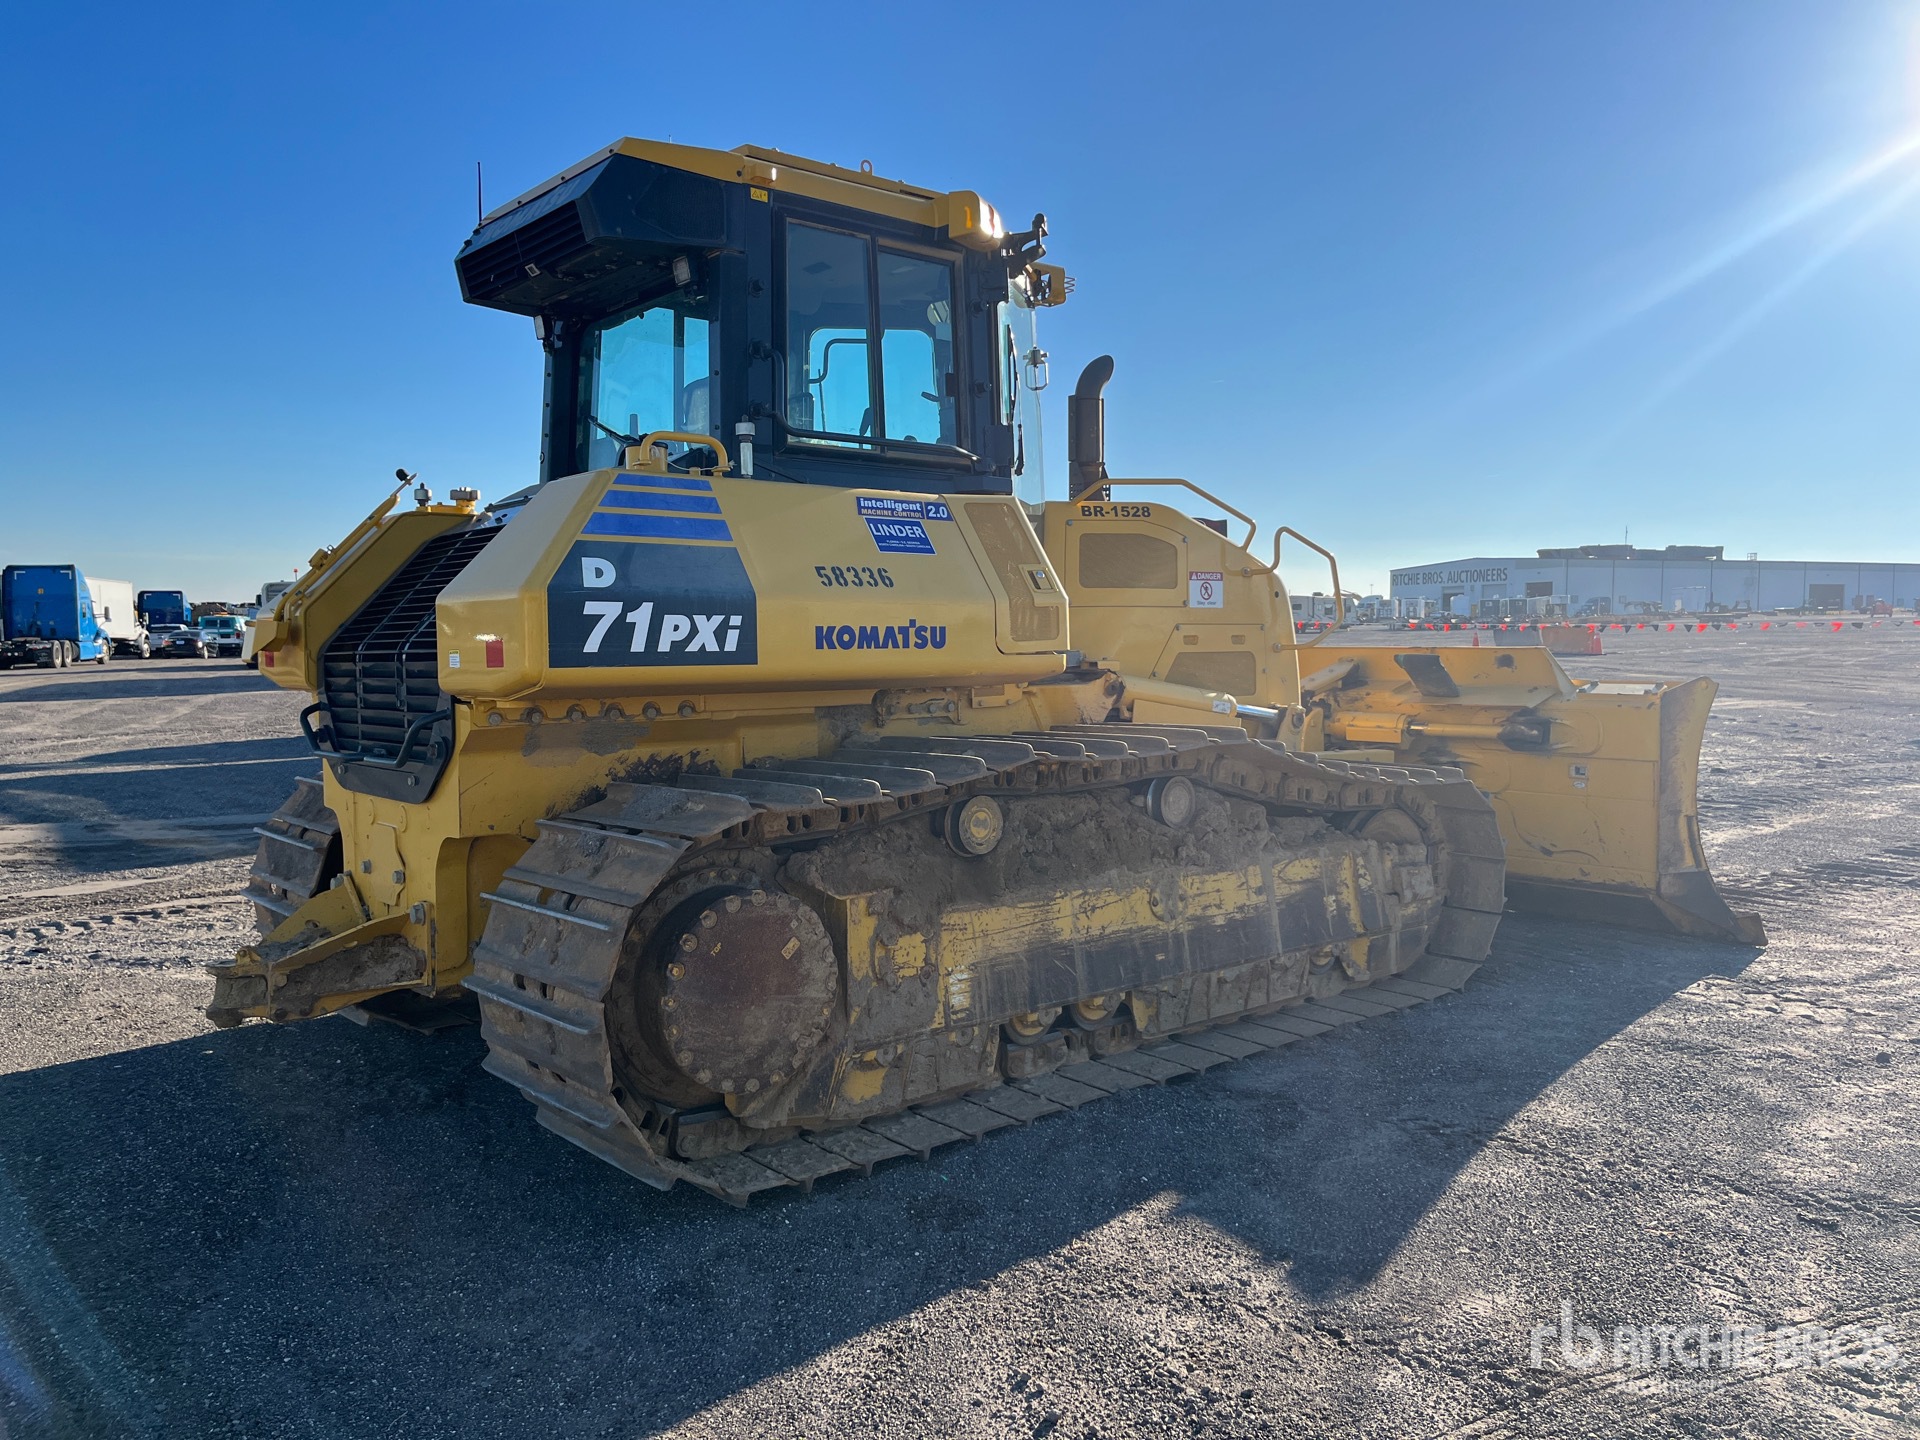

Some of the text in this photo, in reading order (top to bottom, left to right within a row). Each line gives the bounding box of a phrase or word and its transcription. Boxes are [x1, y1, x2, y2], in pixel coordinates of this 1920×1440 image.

[860, 498, 921, 511] intelligent
[927, 505, 948, 518] 2.0
[1080, 505, 1151, 518] BR-1528
[861, 508, 923, 519] MACHINE CONTROL
[869, 523, 925, 538] LINDER
[581, 557, 617, 588] D
[814, 566, 895, 588] 58336
[1197, 572, 1222, 580] DANGER
[1392, 567, 1508, 587] RITCHIE BROS. AUCTIONEERS
[815, 618, 947, 650] KOMATSU
